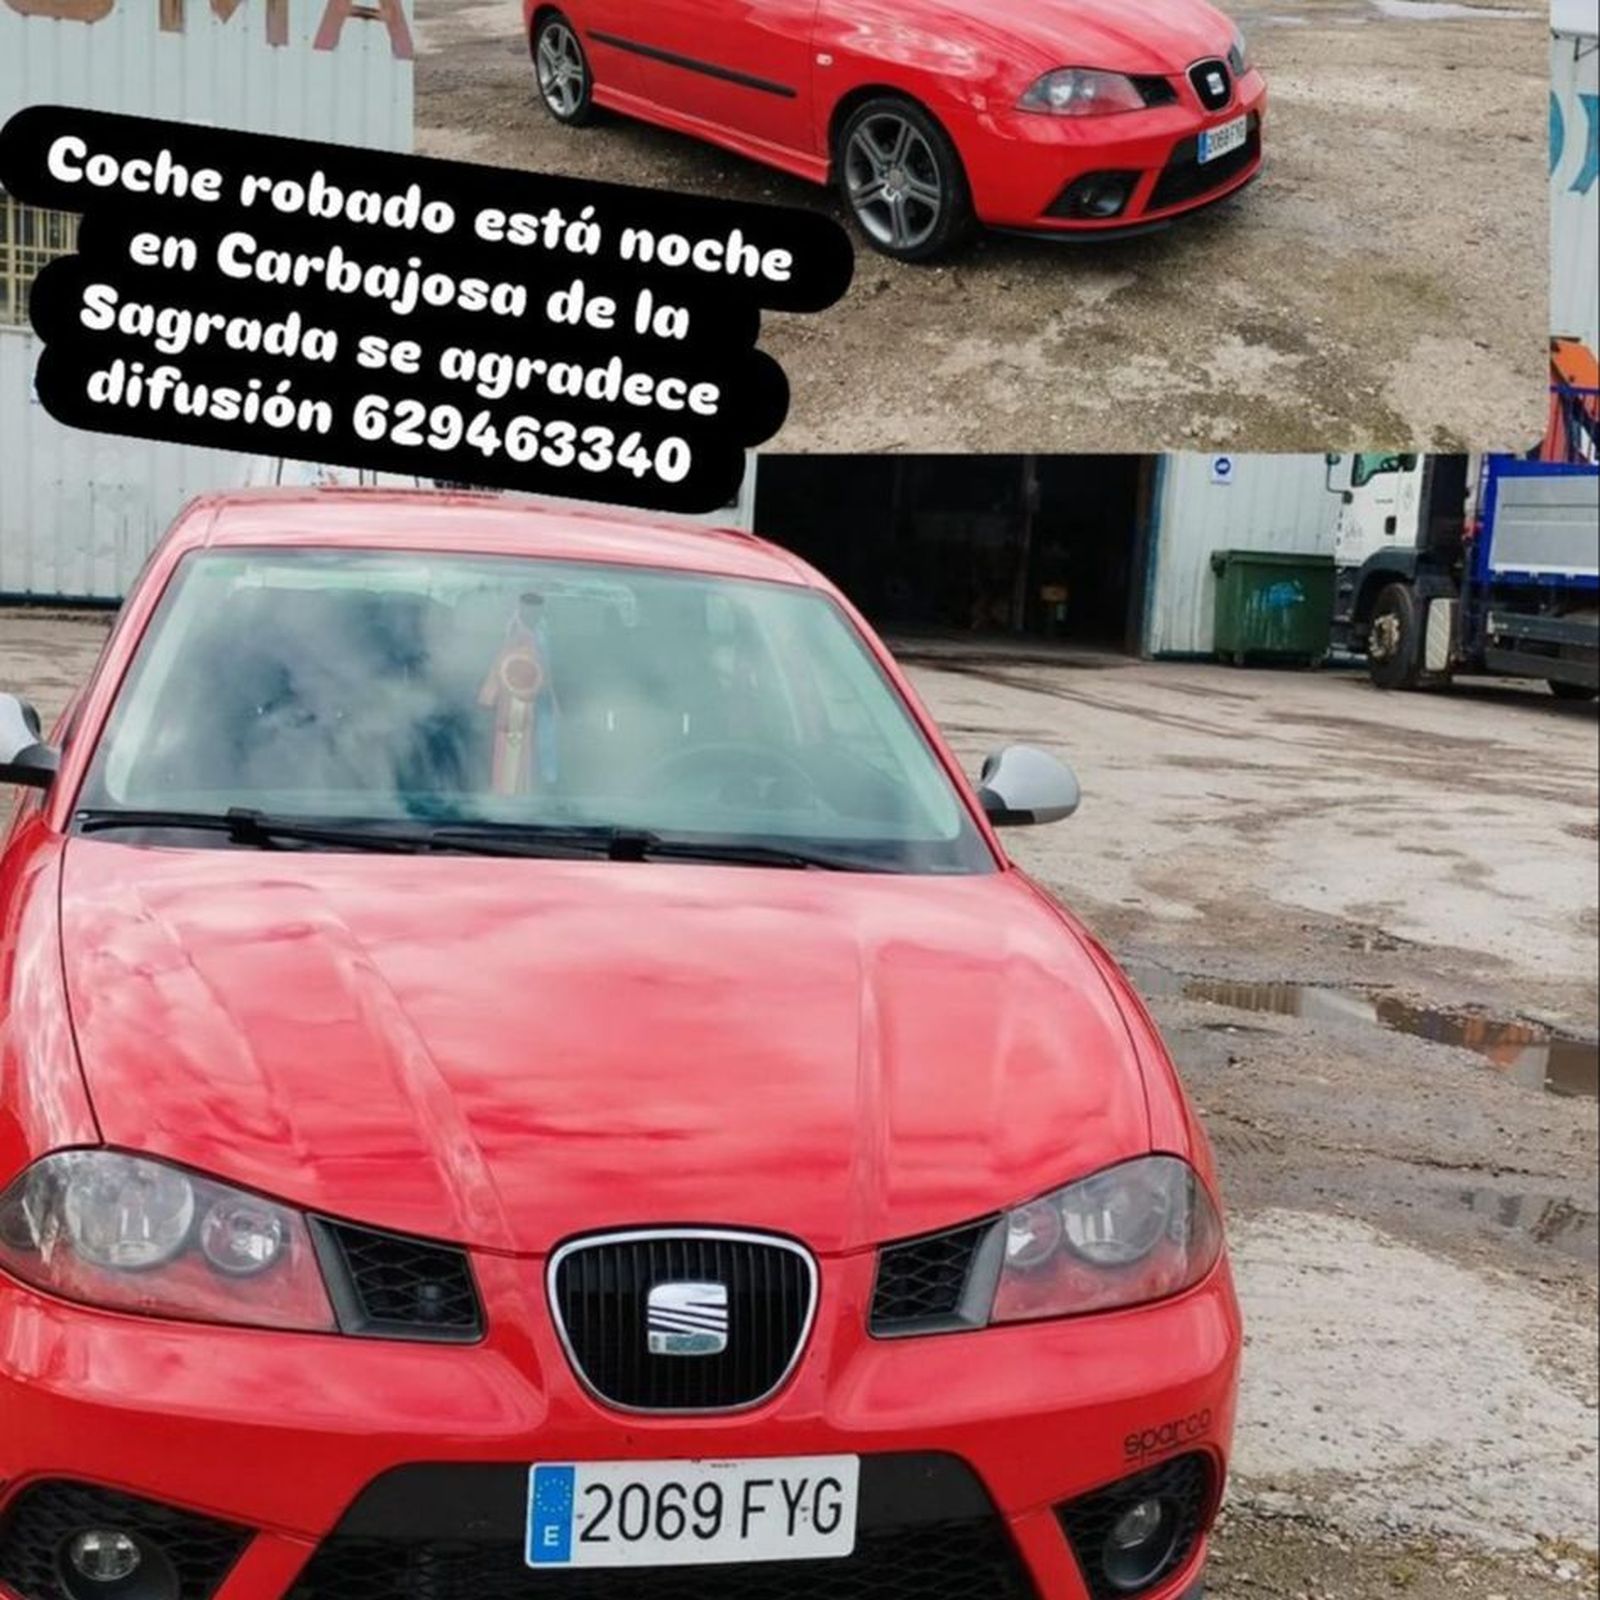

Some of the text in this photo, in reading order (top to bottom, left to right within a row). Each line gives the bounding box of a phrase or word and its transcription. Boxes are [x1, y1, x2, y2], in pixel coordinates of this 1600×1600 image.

[1123, 1407, 1212, 1467] sparco
[543, 1525, 560, 1547] E
[579, 1477, 843, 1542] 2069 FYG
